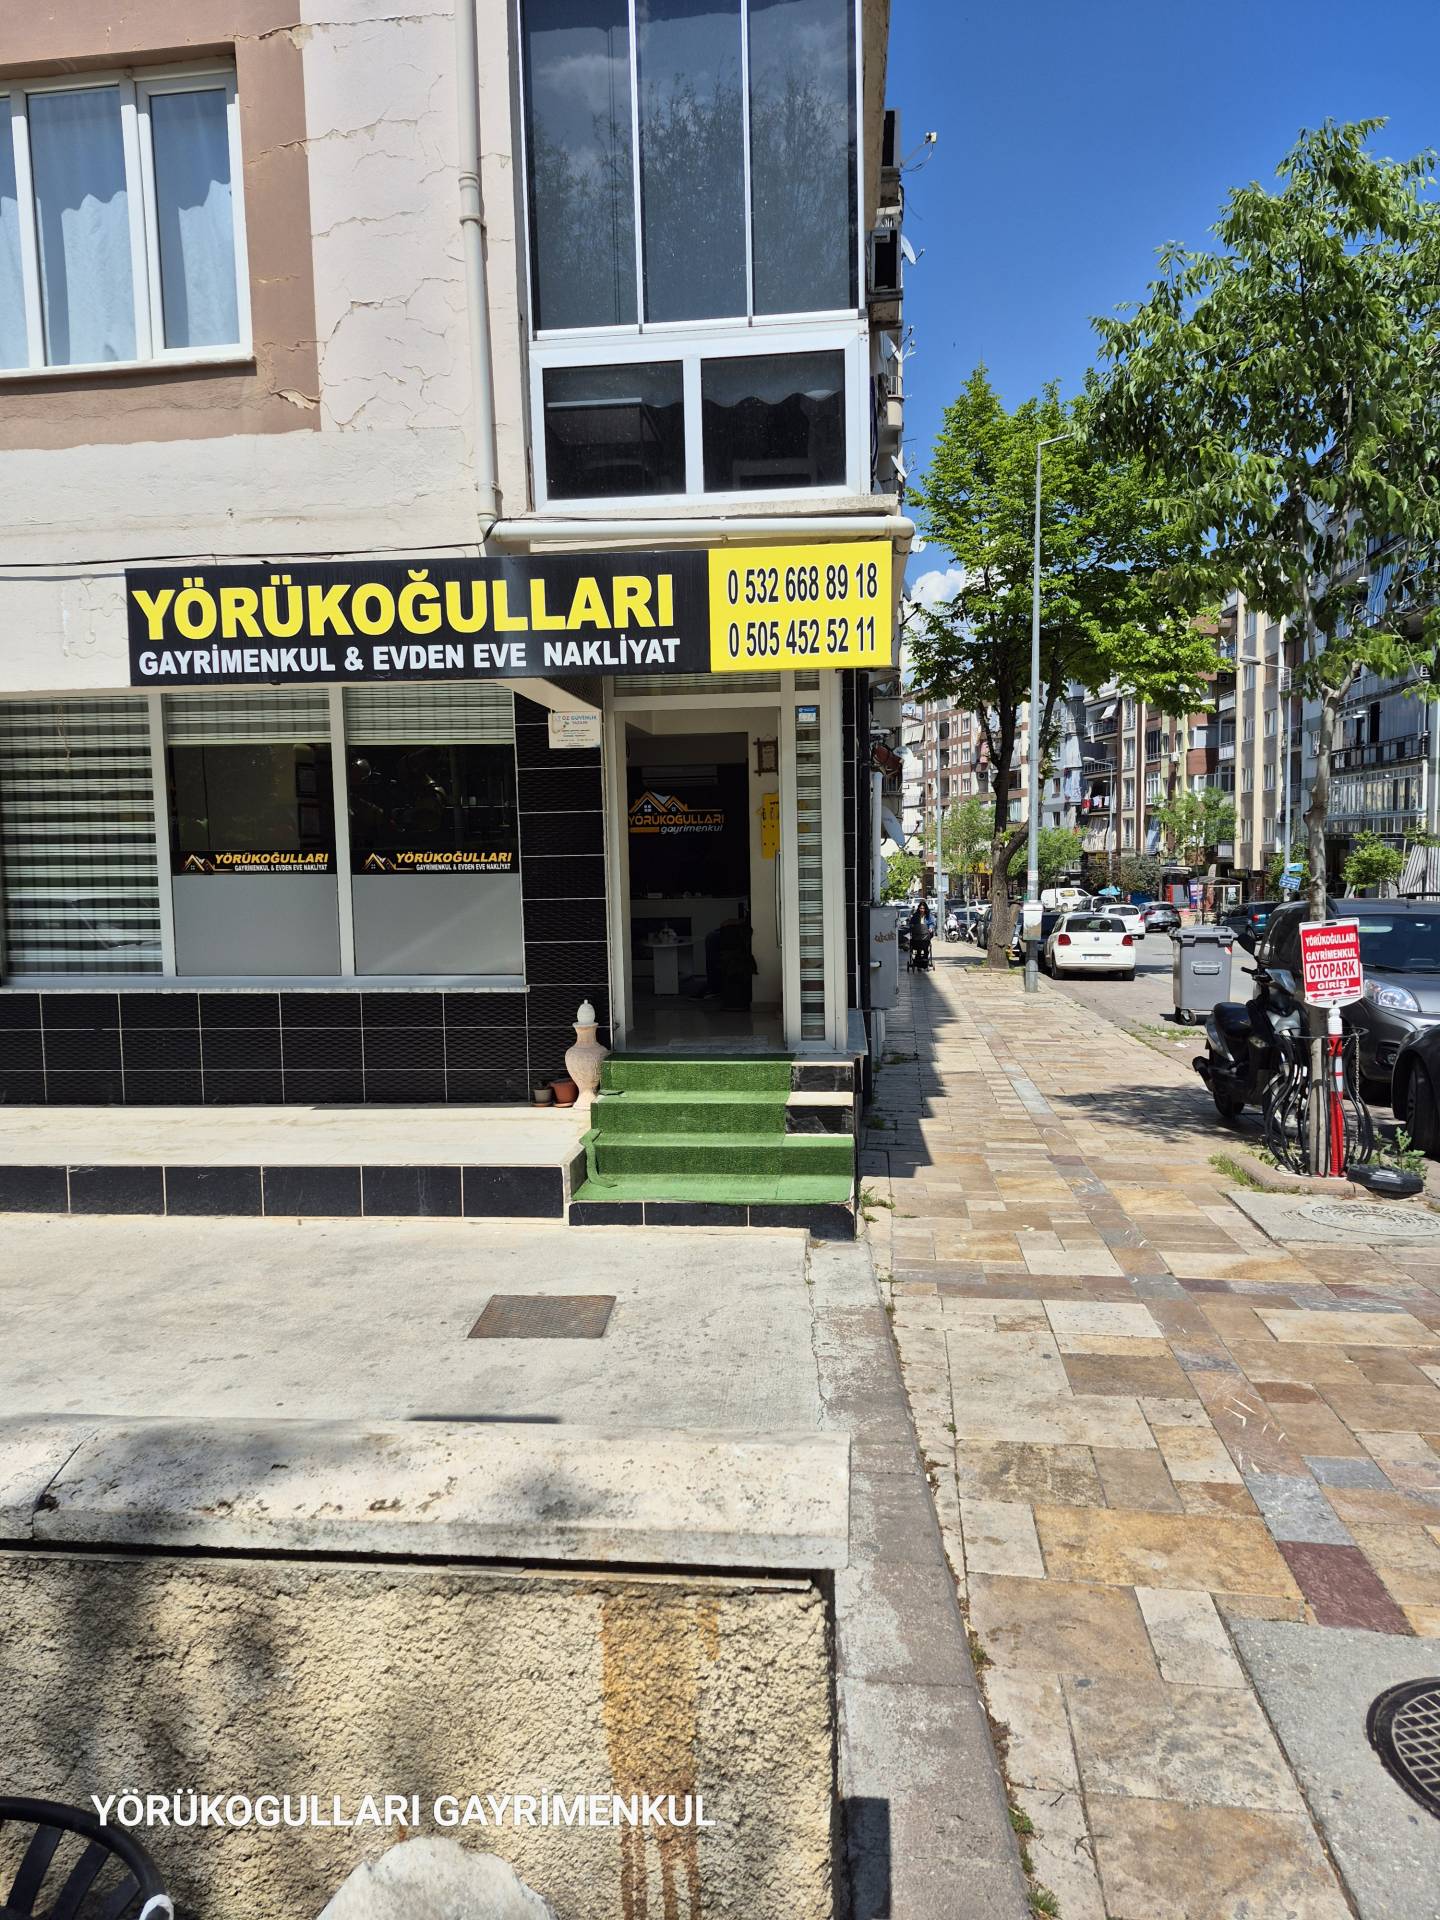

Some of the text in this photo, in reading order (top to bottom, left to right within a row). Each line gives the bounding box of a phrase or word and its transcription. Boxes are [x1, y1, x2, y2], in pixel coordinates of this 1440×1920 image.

[727, 562, 877, 605] 0 532 668 89 18
[131, 569, 674, 641] YÖRÜKOĞULLARI
[729, 615, 875, 658] 0 505 452 52 11
[139, 634, 681, 675] GAYRİMENKUL & EVDEN EVE NAKLİYAT
[215, 852, 329, 864] YÖRÜKOĞULLARI
[396, 851, 512, 863] YÖRÜKOĞULLARI
[1305, 932, 1356, 947] YÖRÜKOĞULLARI
[1306, 948, 1357, 962] GAYRİMENKUL
[1309, 961, 1355, 980] OTOPARK
